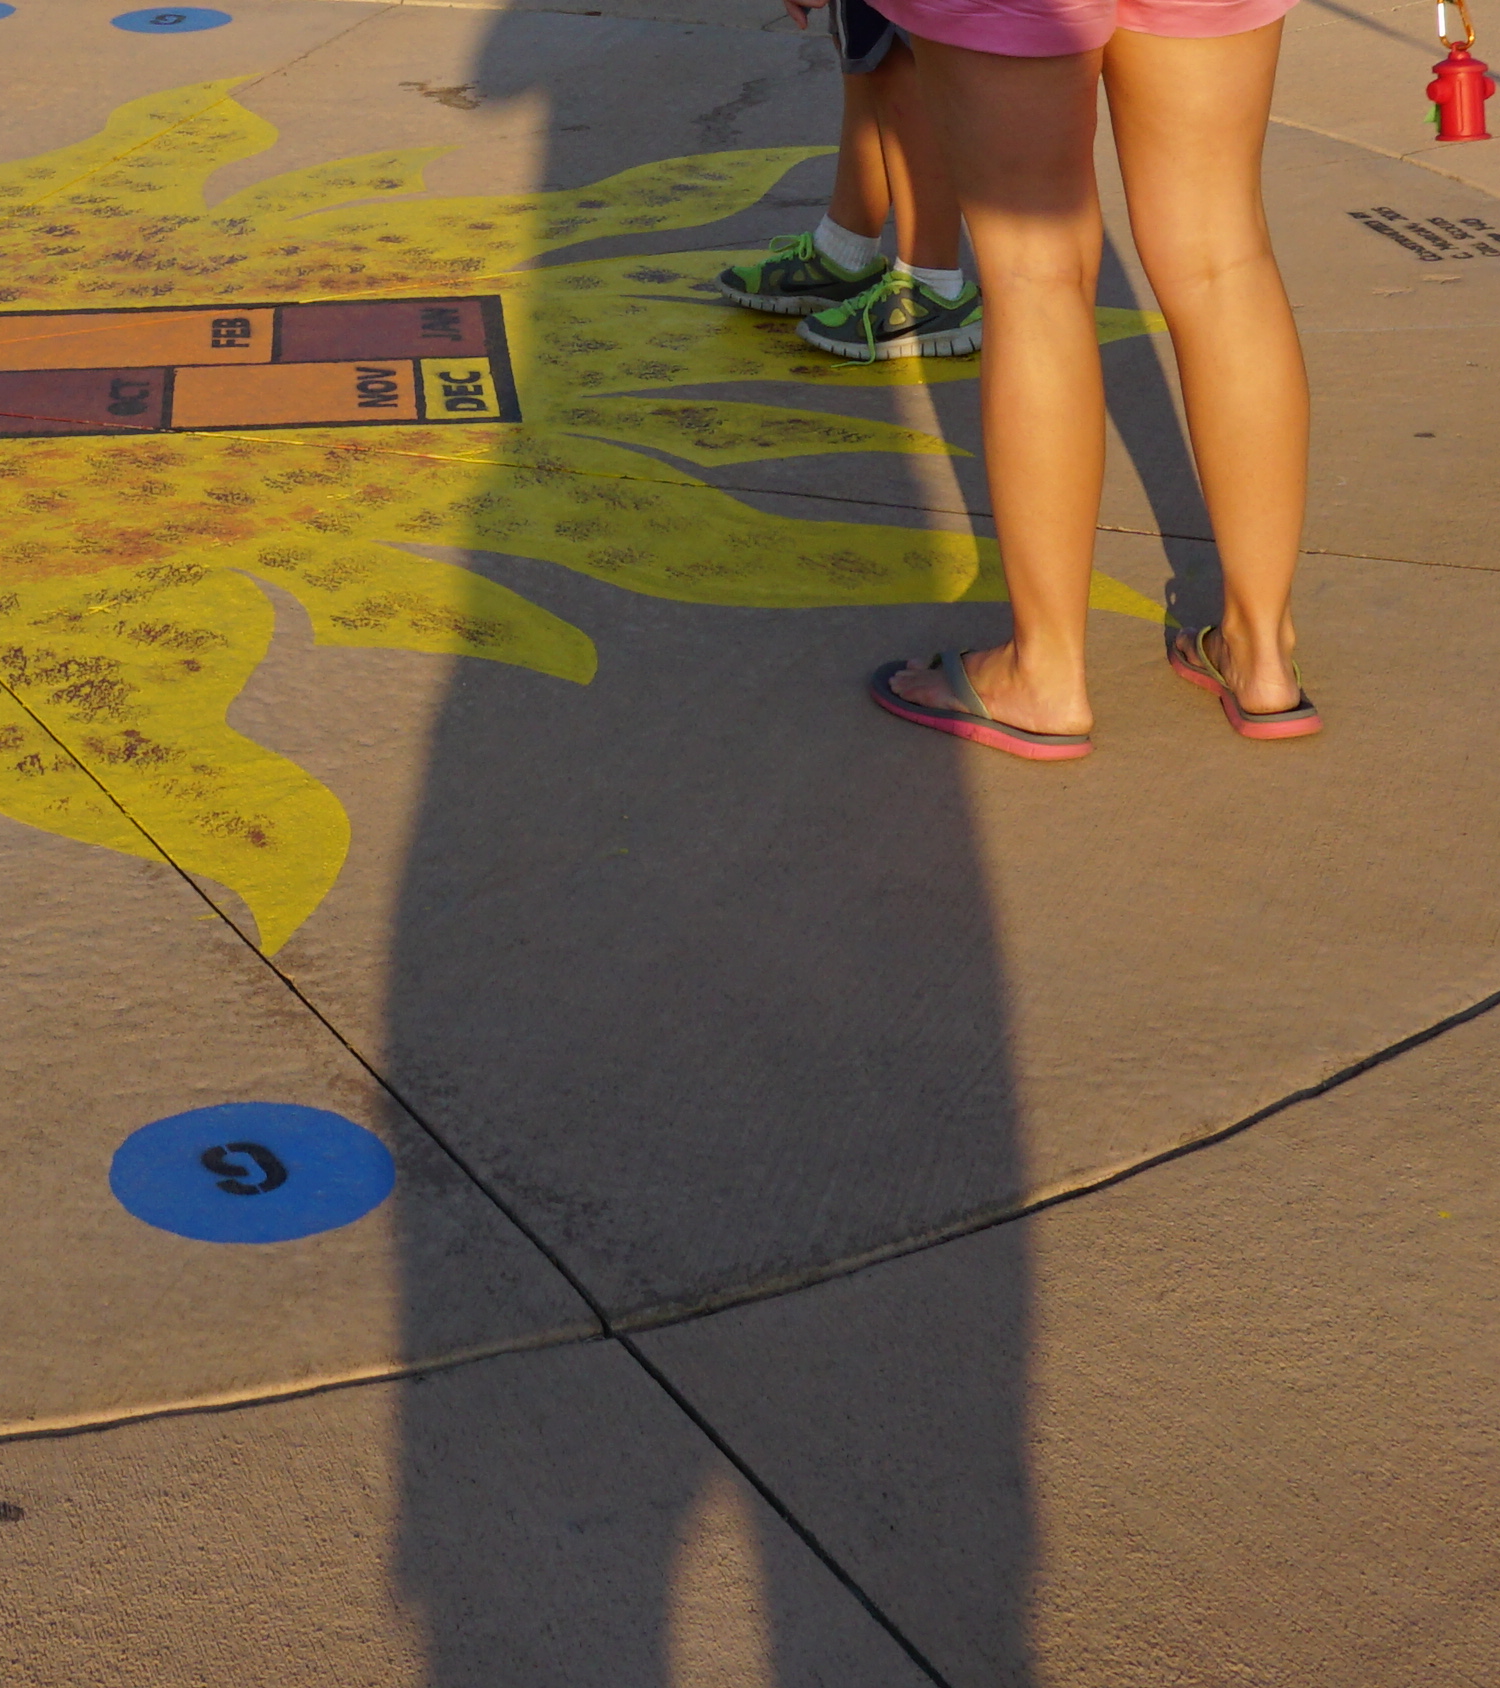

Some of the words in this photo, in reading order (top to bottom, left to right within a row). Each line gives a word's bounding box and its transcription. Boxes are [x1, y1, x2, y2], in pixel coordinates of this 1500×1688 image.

[211, 317, 251, 349] FEB
[419, 307, 462, 342] JAN
[107, 378, 150, 416] OCT
[356, 367, 398, 408] NOV
[439, 371, 488, 412] DEC
[200, 1141, 289, 1197] 6
